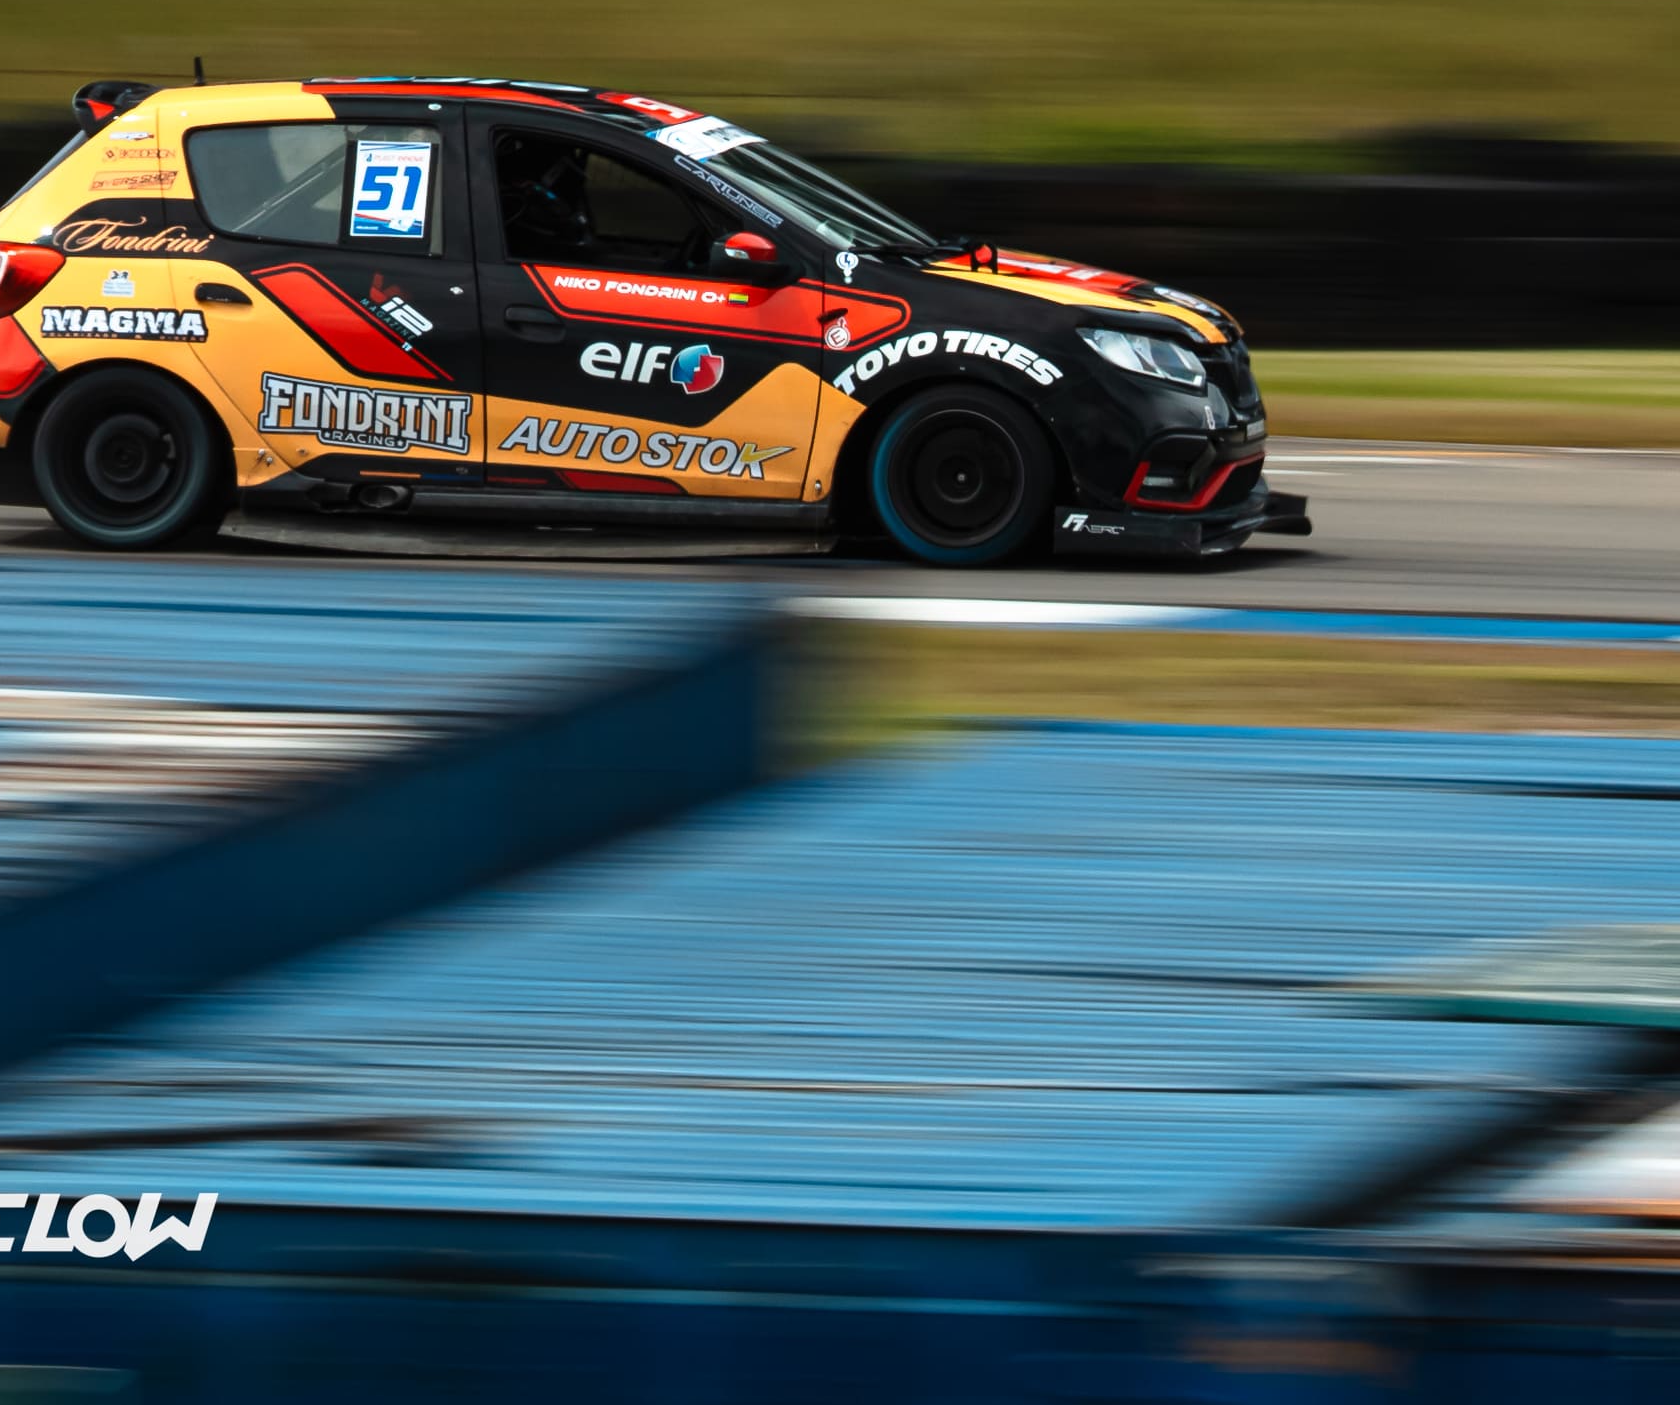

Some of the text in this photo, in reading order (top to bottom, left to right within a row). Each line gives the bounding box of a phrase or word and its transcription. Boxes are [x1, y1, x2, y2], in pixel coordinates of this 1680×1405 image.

[357, 166, 422, 210] 51
[53, 216, 215, 253] Fondrini
[554, 275, 600, 291] NIKO
[604, 280, 696, 302] FONDRINI
[42, 308, 206, 337] MAGMA
[360, 298, 416, 340] MAGAZINE
[579, 342, 672, 384] elf
[832, 330, 1064, 396] TOYO TIRES
[263, 377, 469, 449] FONDRINI
[332, 430, 396, 447] RACING
[498, 416, 793, 479] AUTO STOK
